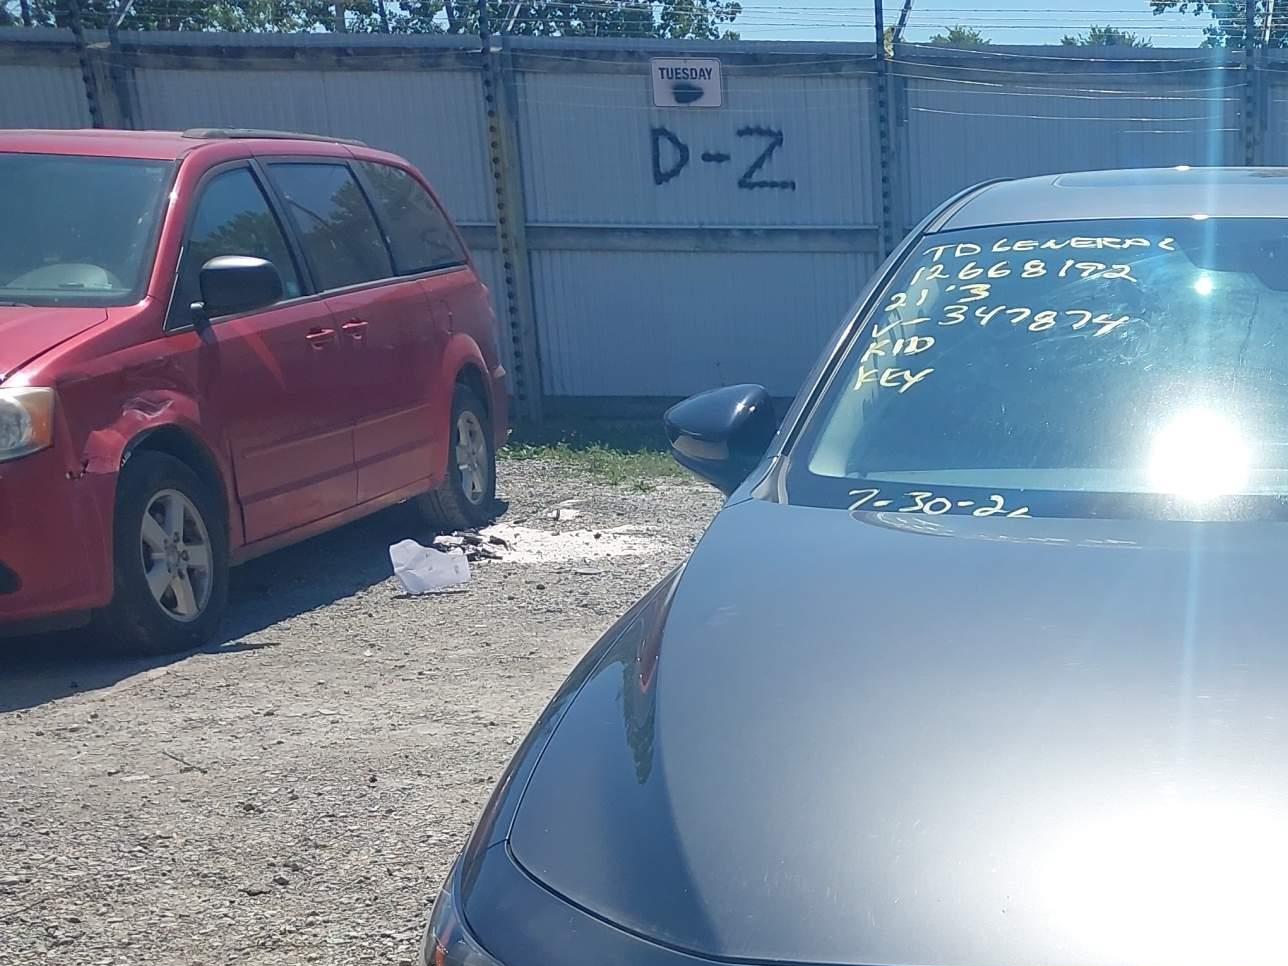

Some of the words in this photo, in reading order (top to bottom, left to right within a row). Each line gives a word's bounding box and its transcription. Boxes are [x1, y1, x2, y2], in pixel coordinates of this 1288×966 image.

[658, 67, 712, 80] TUESDAY
[650, 125, 796, 191] D-Z
[923, 243, 981, 262] TD
[910, 259, 1137, 286] 12668192
[854, 365, 934, 393] KEY
